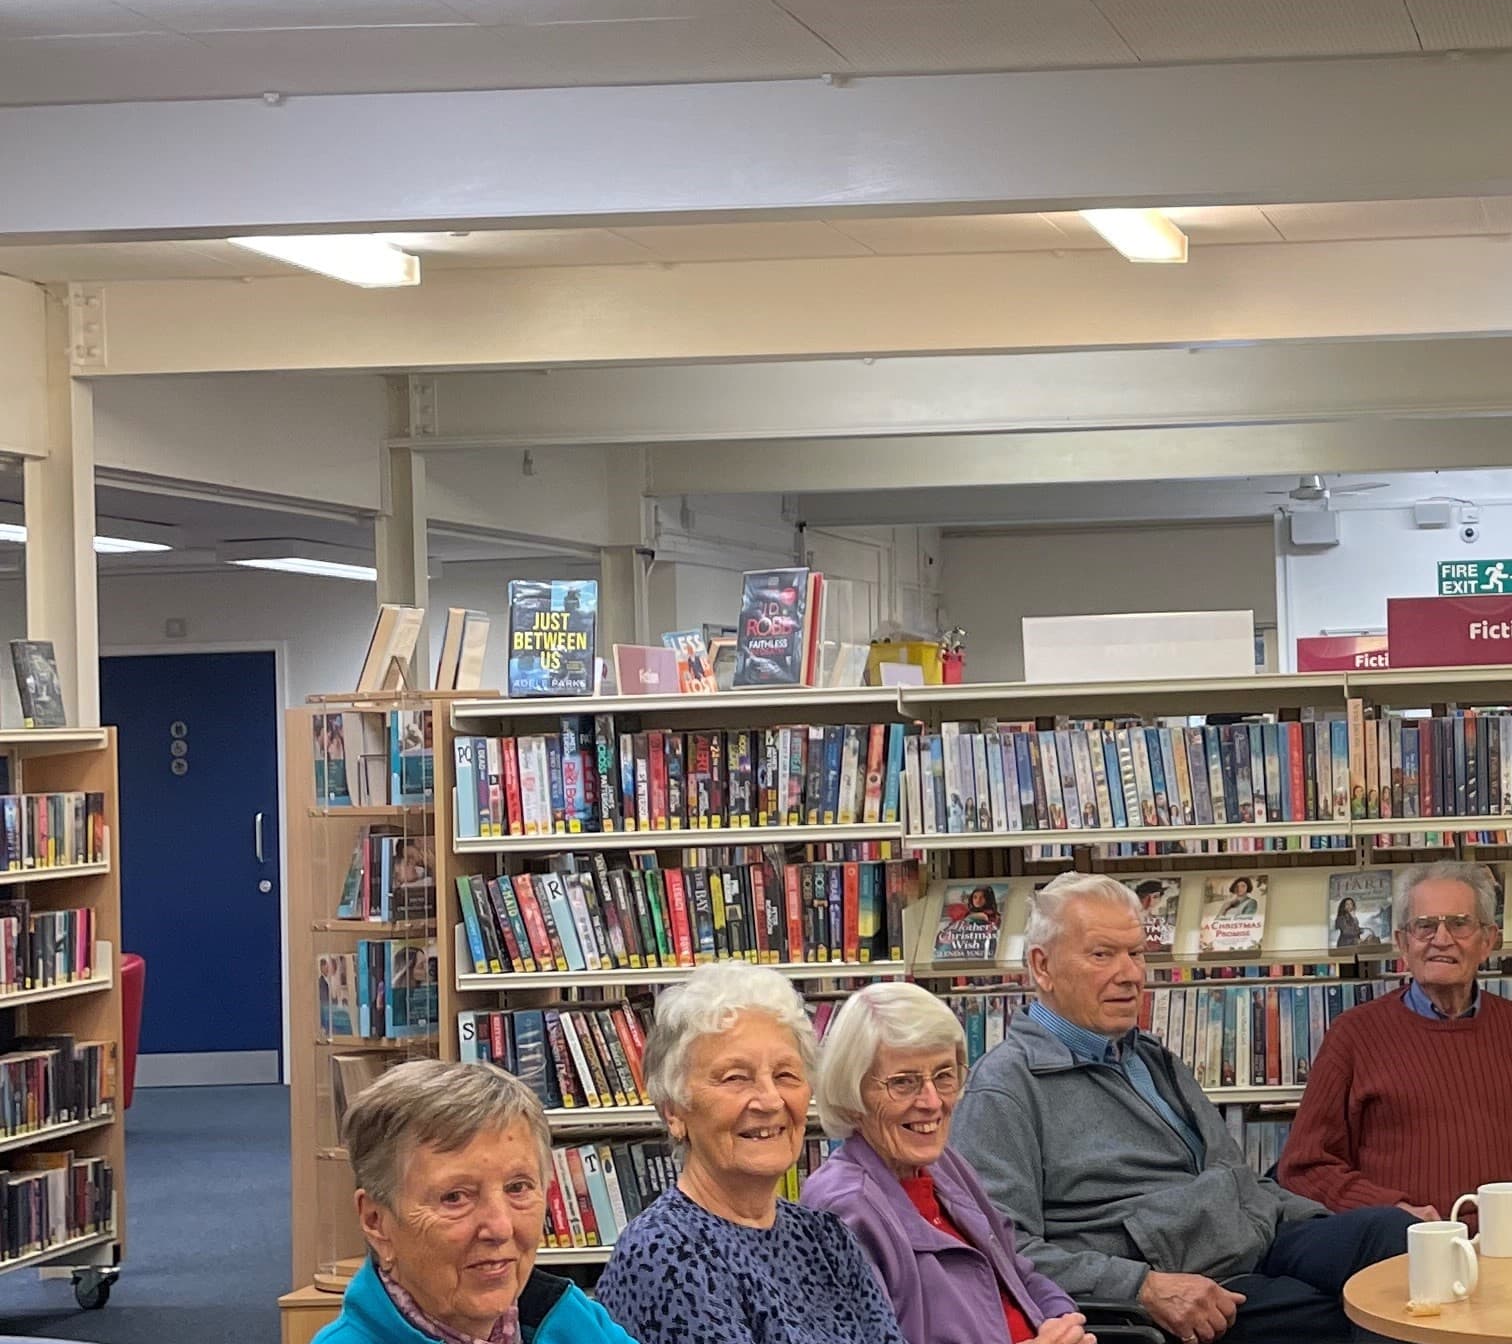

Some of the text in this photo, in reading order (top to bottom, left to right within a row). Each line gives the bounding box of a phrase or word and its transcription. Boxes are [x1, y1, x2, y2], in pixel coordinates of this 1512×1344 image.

[1441, 564, 1478, 578] FIRE
[1442, 580, 1478, 595] EXIT
[532, 611, 570, 630] JUST
[746, 615, 793, 637] ROBB
[513, 631, 587, 651] BETWEEN
[672, 634, 704, 654] LESS
[749, 638, 788, 650] FAITHLESS
[539, 651, 561, 670] US
[1355, 654, 1389, 668] Ficti
[513, 677, 587, 689] ADELE PARKS
[458, 745, 472, 763] PQ
[597, 744, 607, 774] CROSS
[600, 775, 609, 818] PATTERSON
[638, 782, 648, 817] PATTERSO
[548, 880, 563, 899] R
[694, 872, 709, 913] THE BAY
[502, 890, 518, 917] MAID
[1211, 920, 1261, 931] CHRISTMAS
[1215, 929, 1250, 938] PROMISE
[938, 930, 998, 941] Christmas
[952, 938, 980, 949] Wish
[463, 1022, 475, 1041] S
[585, 1153, 597, 1173] T
